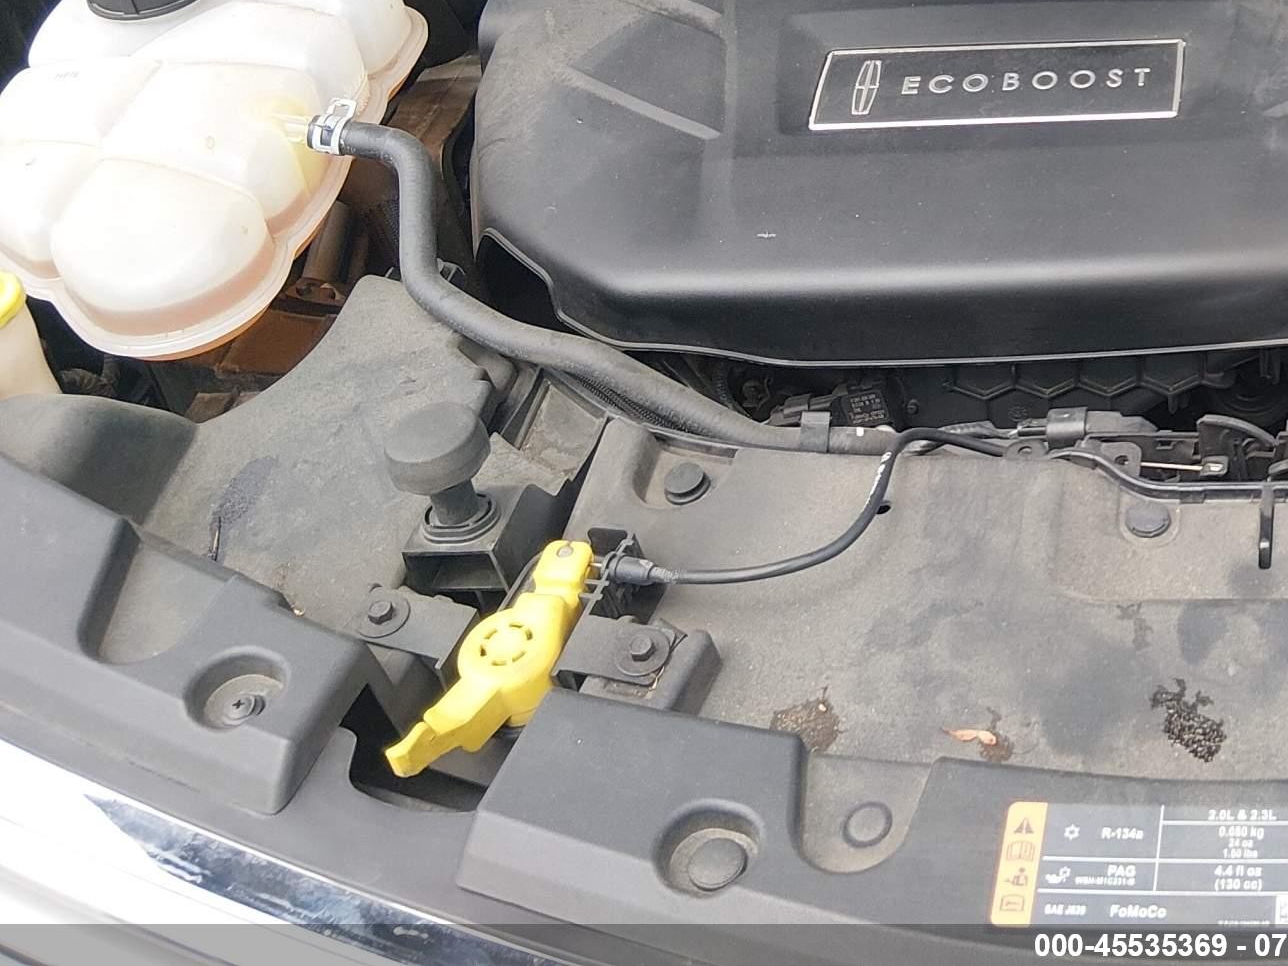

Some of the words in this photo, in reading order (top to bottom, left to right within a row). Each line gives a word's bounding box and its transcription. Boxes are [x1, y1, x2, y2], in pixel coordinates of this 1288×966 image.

[901, 67, 1151, 95] ECOBOOST
[1208, 809, 1235, 821] 2.0L
[1237, 810, 1247, 821] &
[1250, 809, 1277, 821] 2.3L
[1101, 827, 1144, 840] R-134a
[1250, 826, 1265, 840] kg
[1107, 864, 1137, 877] PAG
[1214, 865, 1233, 877] 4.4
[1247, 866, 1263, 877] oz
[1109, 904, 1167, 919] FoMoCo
